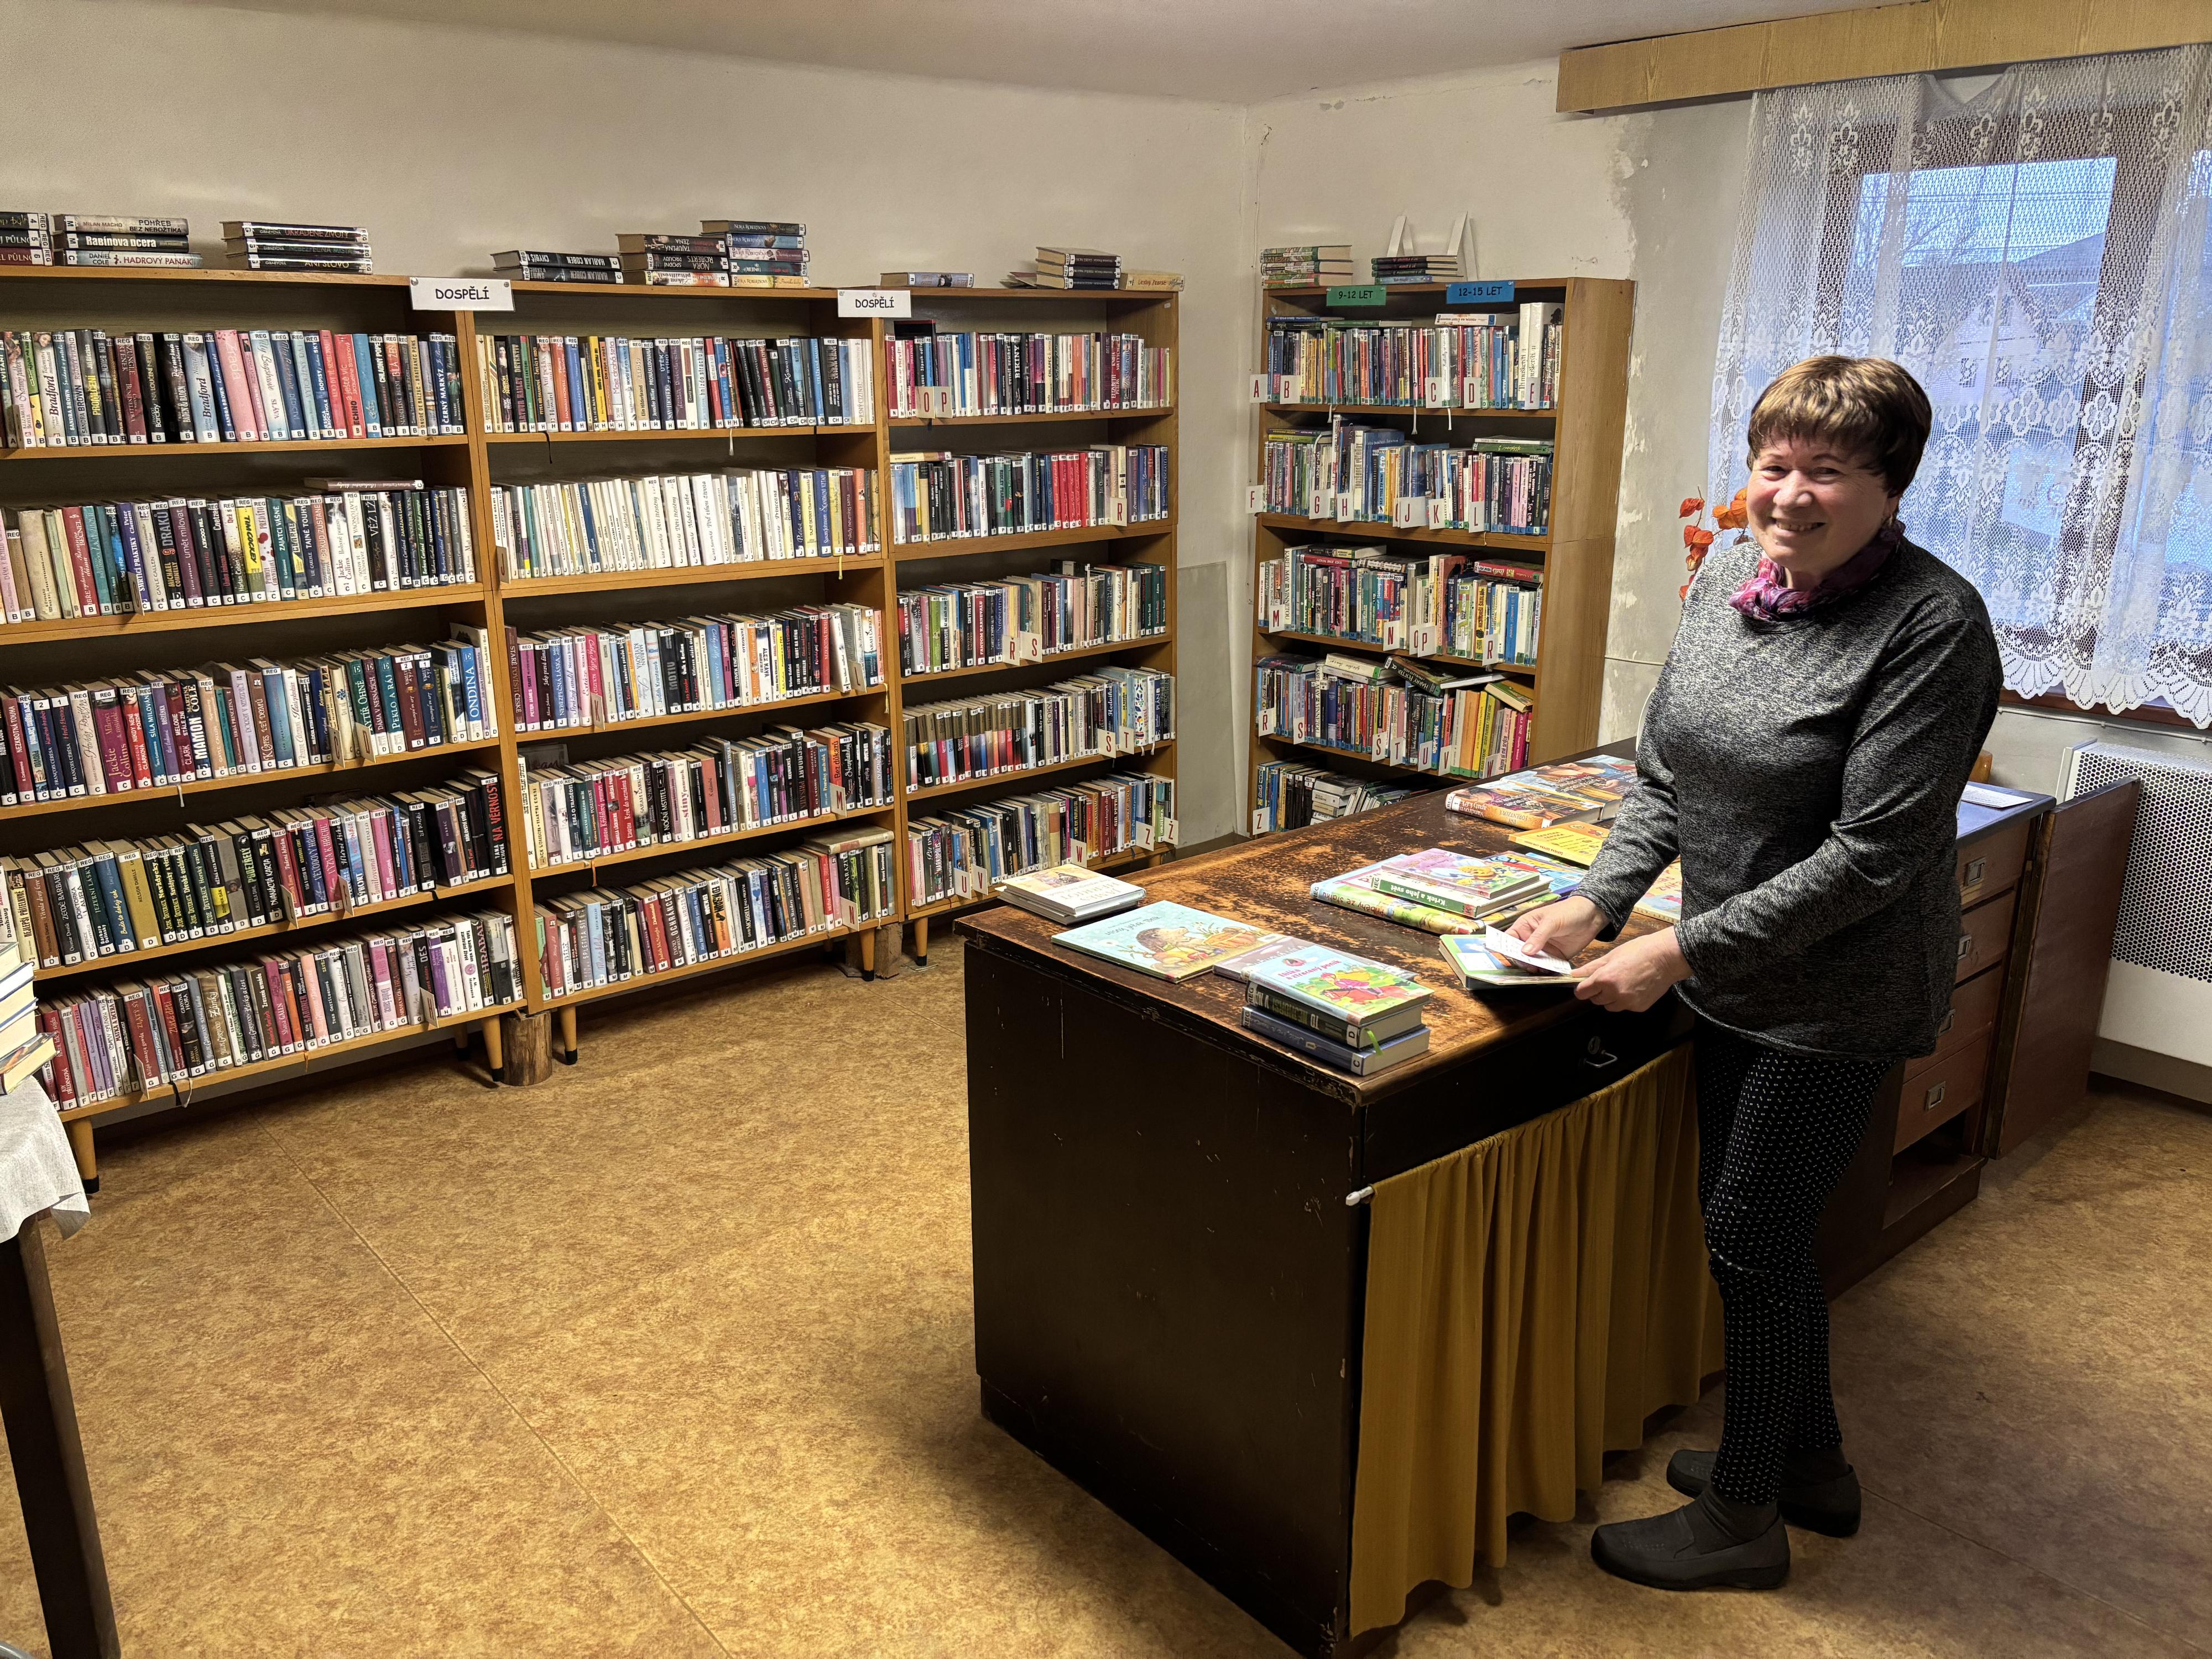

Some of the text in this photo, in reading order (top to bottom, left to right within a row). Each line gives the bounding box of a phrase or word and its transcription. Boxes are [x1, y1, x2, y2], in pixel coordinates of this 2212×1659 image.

[435, 286, 489, 300] DOSPĚLÍ
[1338, 290, 1373, 300] 9-12 LET
[1458, 286, 1501, 296] 12-15 LET
[855, 296, 894, 308] DOSPĚLÍ
[43, 375, 59, 416] Bradford
[75, 385, 85, 411] BROWN
[86, 375, 101, 415] PROMLČENÍ
[196, 378, 212, 418] Bradford
[436, 368, 450, 424] ČERNÝ MARKÝZ
[1254, 380, 1260, 398] A
[1284, 380, 1290, 399] B
[1431, 383, 1436, 401] C
[1468, 383, 1475, 403] D
[1530, 383, 1535, 404] E
[924, 392, 929, 413] O
[942, 392, 947, 412] P
[1250, 491, 1255, 508] F
[1314, 495, 1319, 514] G
[1342, 502, 1348, 516] H
[1117, 503, 1122, 521] R
[1404, 505, 1410, 523] J
[1434, 504, 1439, 524] K
[1474, 509, 1478, 527] L
[154, 511, 174, 546] DRAKŮ
[176, 509, 191, 559] umět milovat
[368, 515, 379, 536] VĚŽ
[336, 559, 345, 578] Jackie
[344, 557, 352, 580] Collins
[1273, 610, 1279, 627] M
[1388, 629, 1394, 645] N
[1422, 633, 1427, 650] P
[1032, 639, 1038, 656] S
[1487, 640, 1493, 660] R
[356, 680, 368, 703] OHNĚ
[385, 675, 394, 689] RÁJ
[187, 684, 200, 712] COLE
[466, 666, 479, 718] ONDINA
[389, 701, 401, 729] PEKLO
[8, 706, 23, 753] NEZKROTNÁ TOUHA
[129, 727, 138, 742] NIKDY
[189, 717, 208, 760] MAMON
[1297, 724, 1303, 742] S
[1124, 732, 1129, 748] T
[1376, 733, 1381, 755] Š
[119, 743, 132, 778] Collins
[183, 744, 192, 765] CLARK
[832, 740, 841, 765] důkazů
[1395, 742, 1400, 760] T
[1423, 747, 1428, 765] U
[1443, 751, 1449, 769] V
[105, 748, 122, 776] Jackie
[836, 791, 843, 810] M
[1256, 812, 1262, 830] Z
[493, 827, 503, 841] NA
[1145, 828, 1151, 845] Z
[1077, 846, 1083, 863] W
[241, 847, 257, 883] PODEZŘELÝ
[961, 875, 967, 894] U
[978, 872, 983, 889] V
[1426, 894, 1446, 906] Krtek
[849, 905, 854, 925] N
